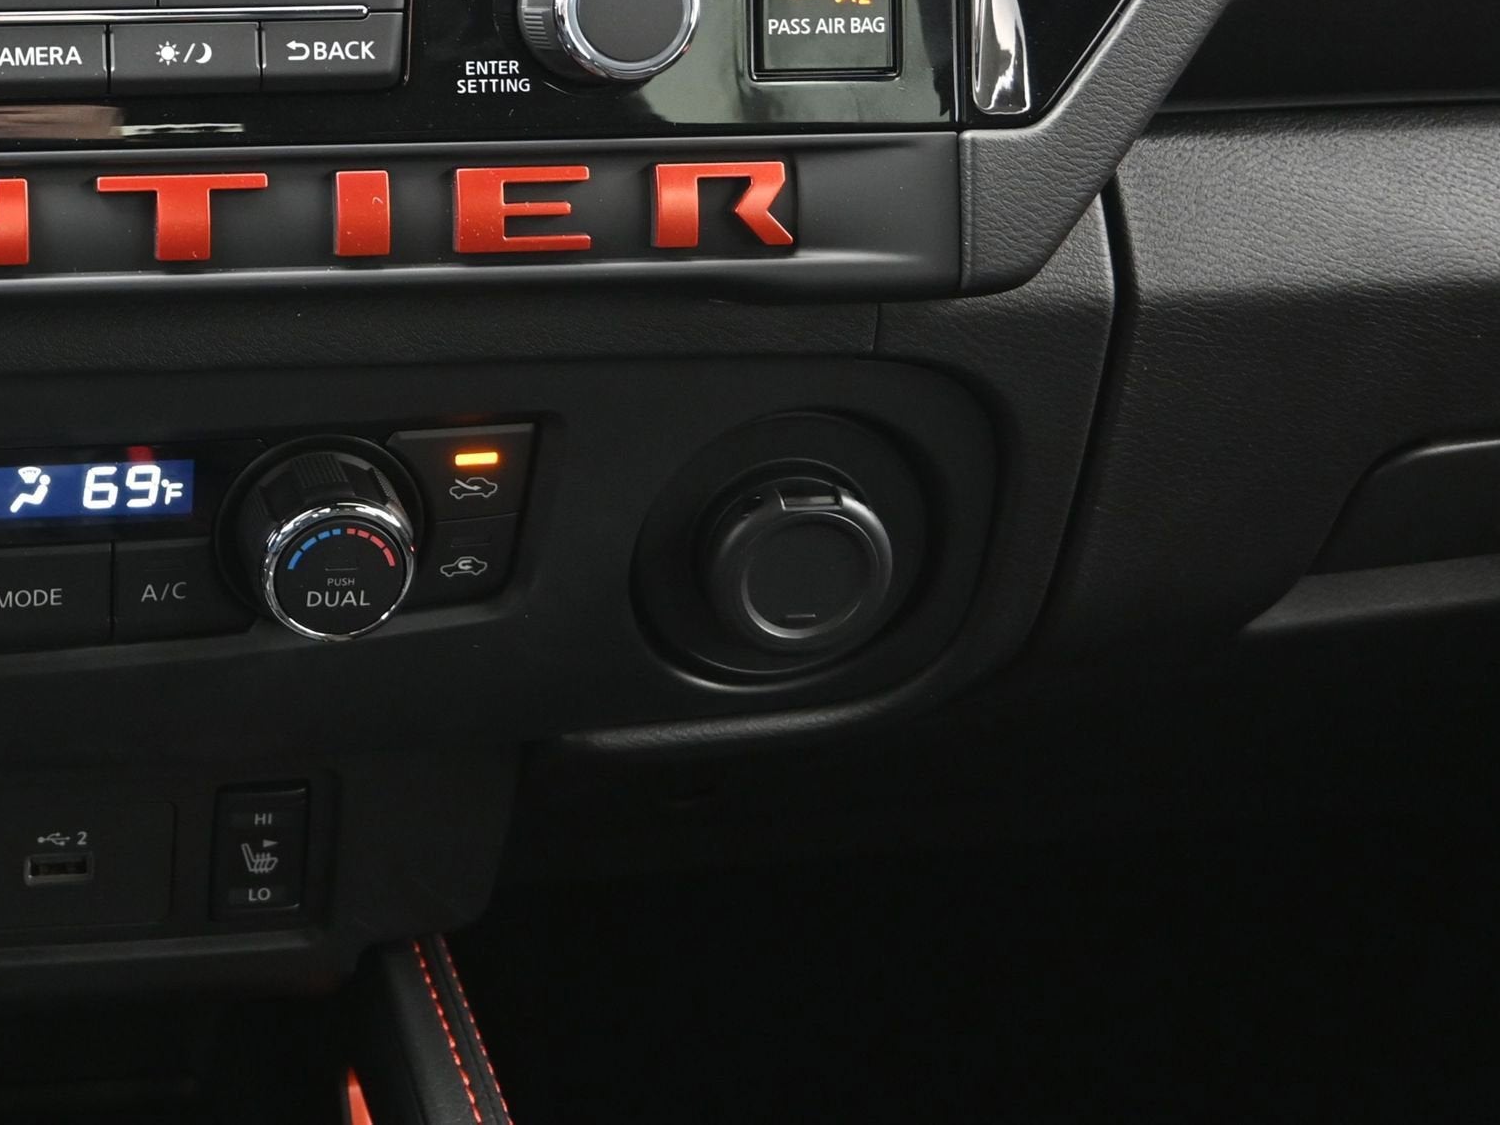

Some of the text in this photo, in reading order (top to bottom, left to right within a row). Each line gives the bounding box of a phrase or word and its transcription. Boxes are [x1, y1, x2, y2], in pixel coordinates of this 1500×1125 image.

[767, 16, 886, 36] PASS AIR BAG
[313, 40, 376, 61] BACK
[465, 60, 520, 76] ENTER
[455, 77, 532, 95] SETTING
[327, 577, 355, 587] PUSH
[141, 581, 186, 602] A/C
[306, 590, 370, 608] DUAL
[254, 813, 273, 826] HI
[77, 831, 87, 846] 2
[248, 887, 271, 902] LO
